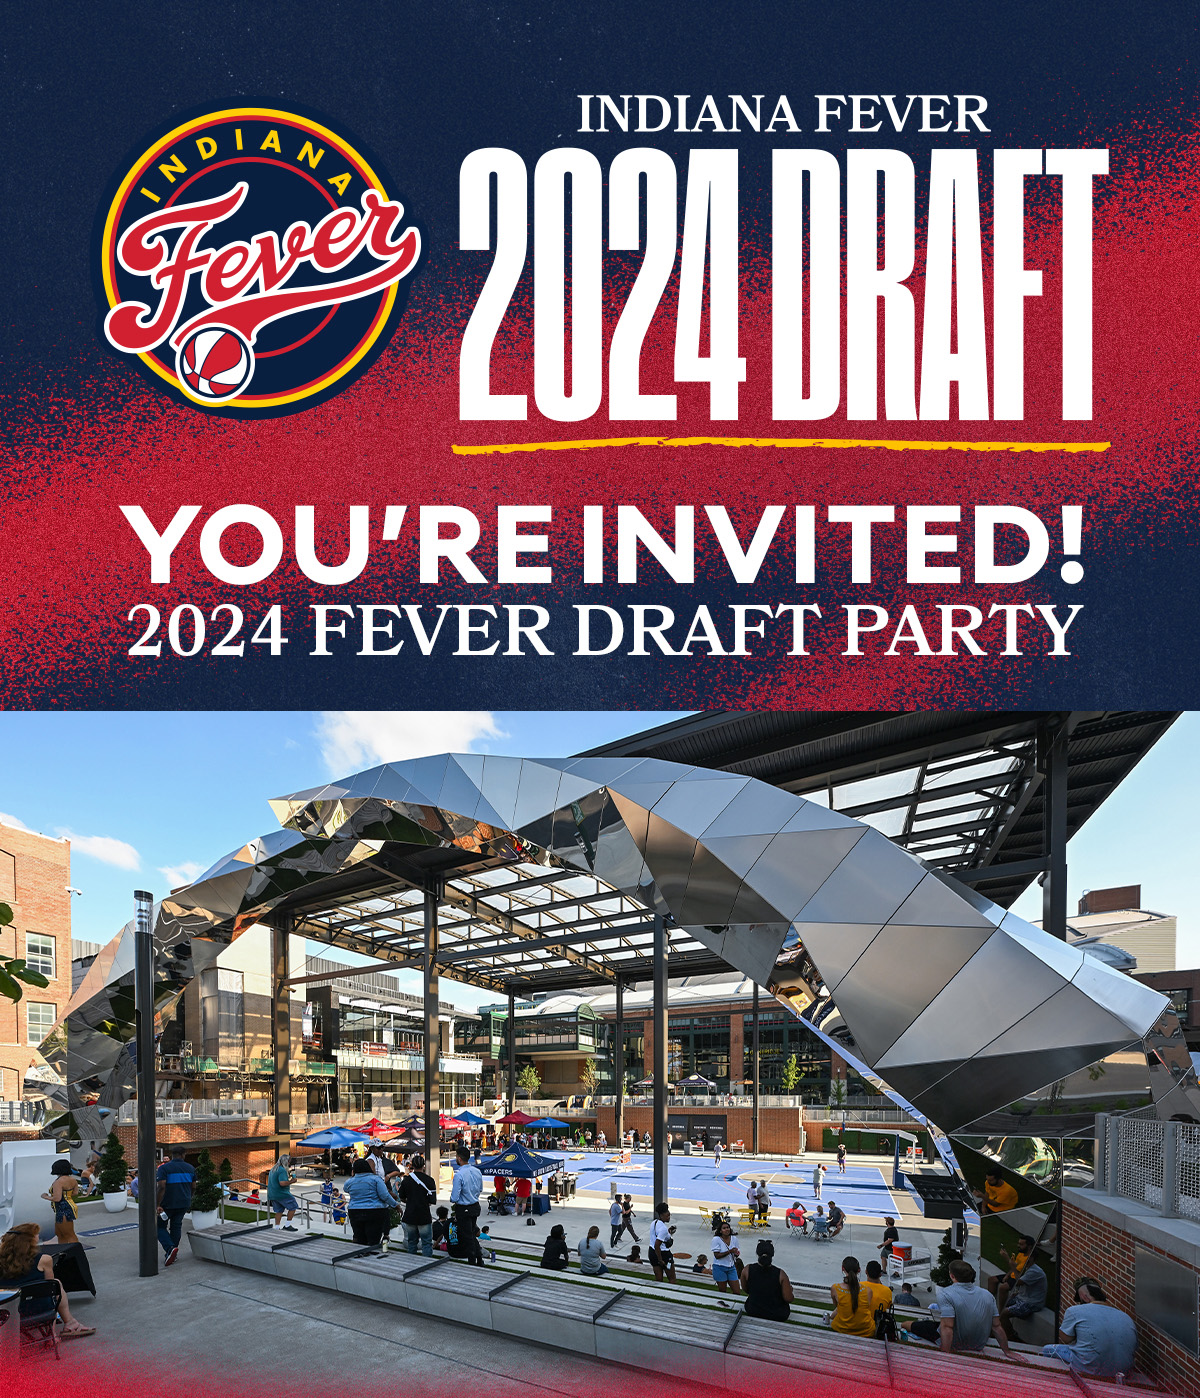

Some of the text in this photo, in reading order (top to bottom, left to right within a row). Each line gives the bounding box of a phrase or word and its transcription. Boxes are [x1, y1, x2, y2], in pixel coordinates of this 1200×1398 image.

[577, 94, 992, 132] INDIANA FEVER
[140, 128, 352, 203] INDIANA
[104, 181, 422, 354] Fever
[459, 147, 1110, 423] 2024 DRAFT
[118, 503, 1084, 586] YOU'RE INVITED!
[127, 603, 1084, 657] 2024 FEVER DRAFT PARTY
